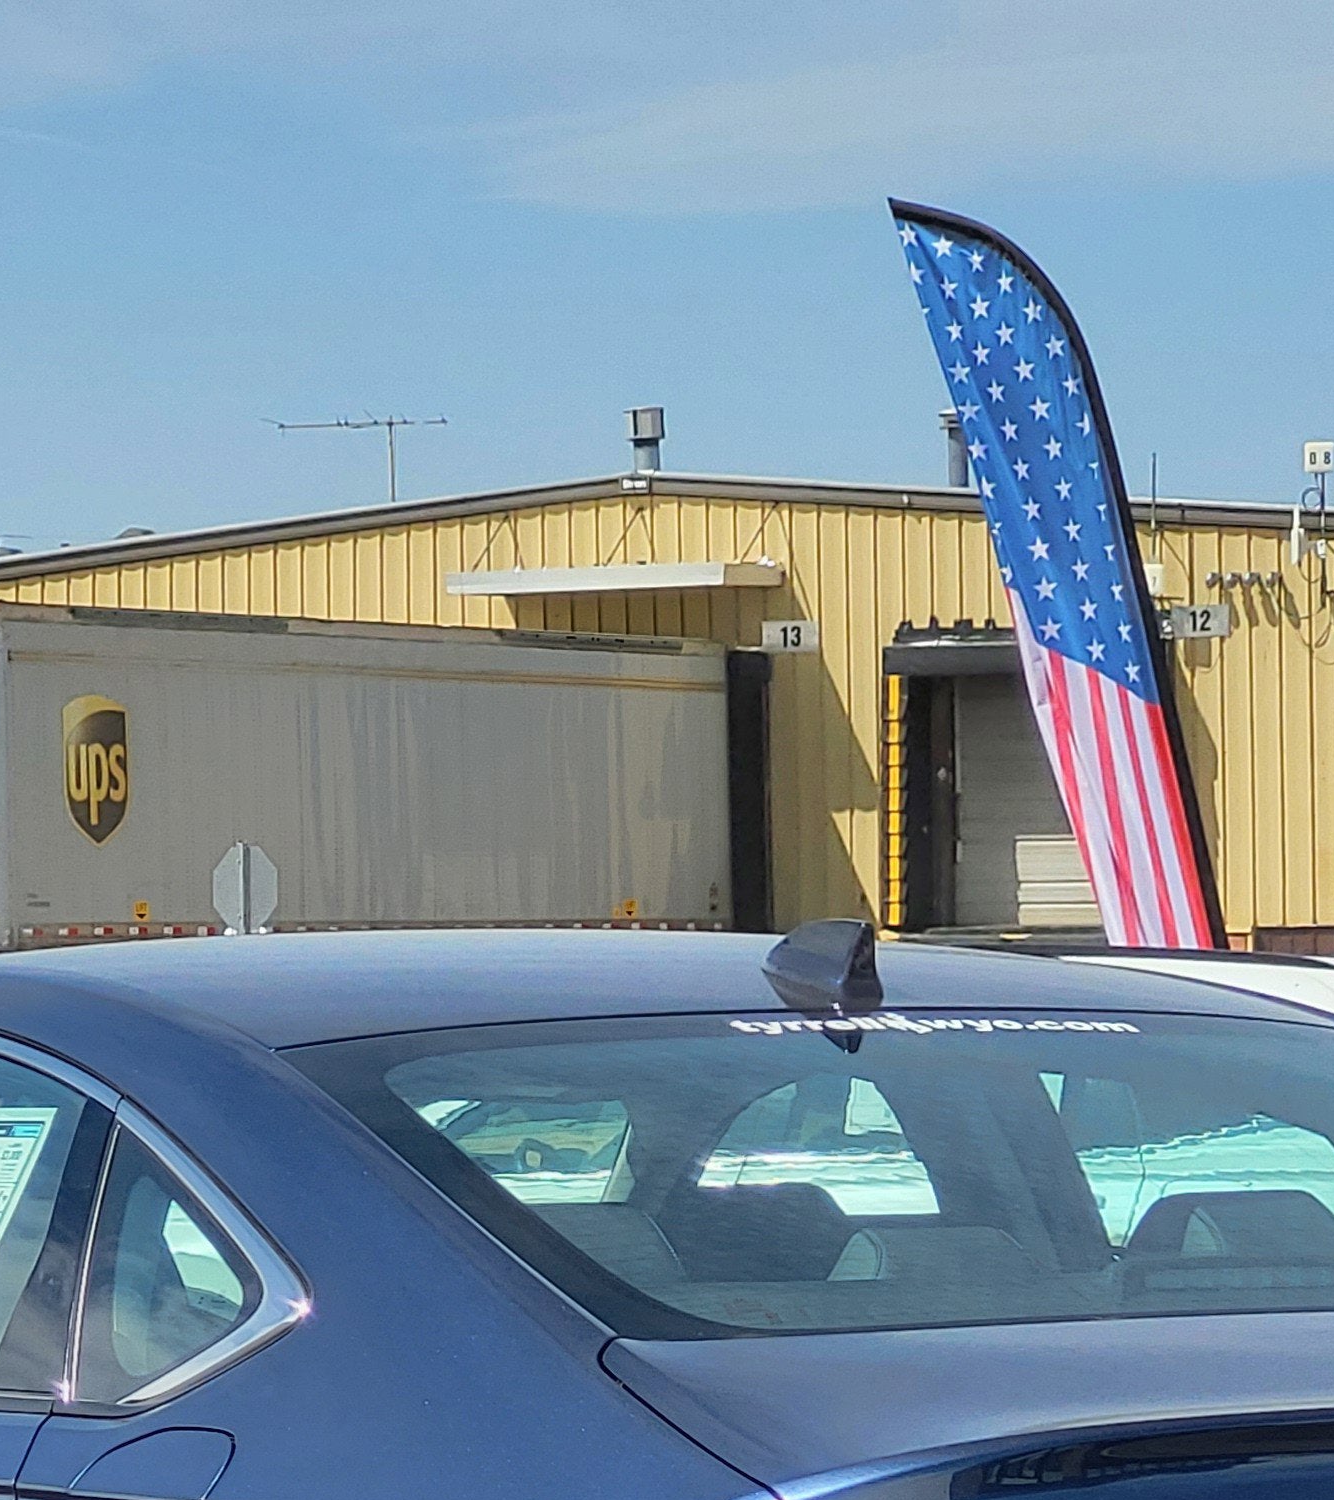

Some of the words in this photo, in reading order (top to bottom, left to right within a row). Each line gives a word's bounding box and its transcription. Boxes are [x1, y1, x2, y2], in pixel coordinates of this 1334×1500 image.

[1189, 609, 1212, 632] 12
[779, 626, 802, 648] 13
[67, 742, 127, 826] ups
